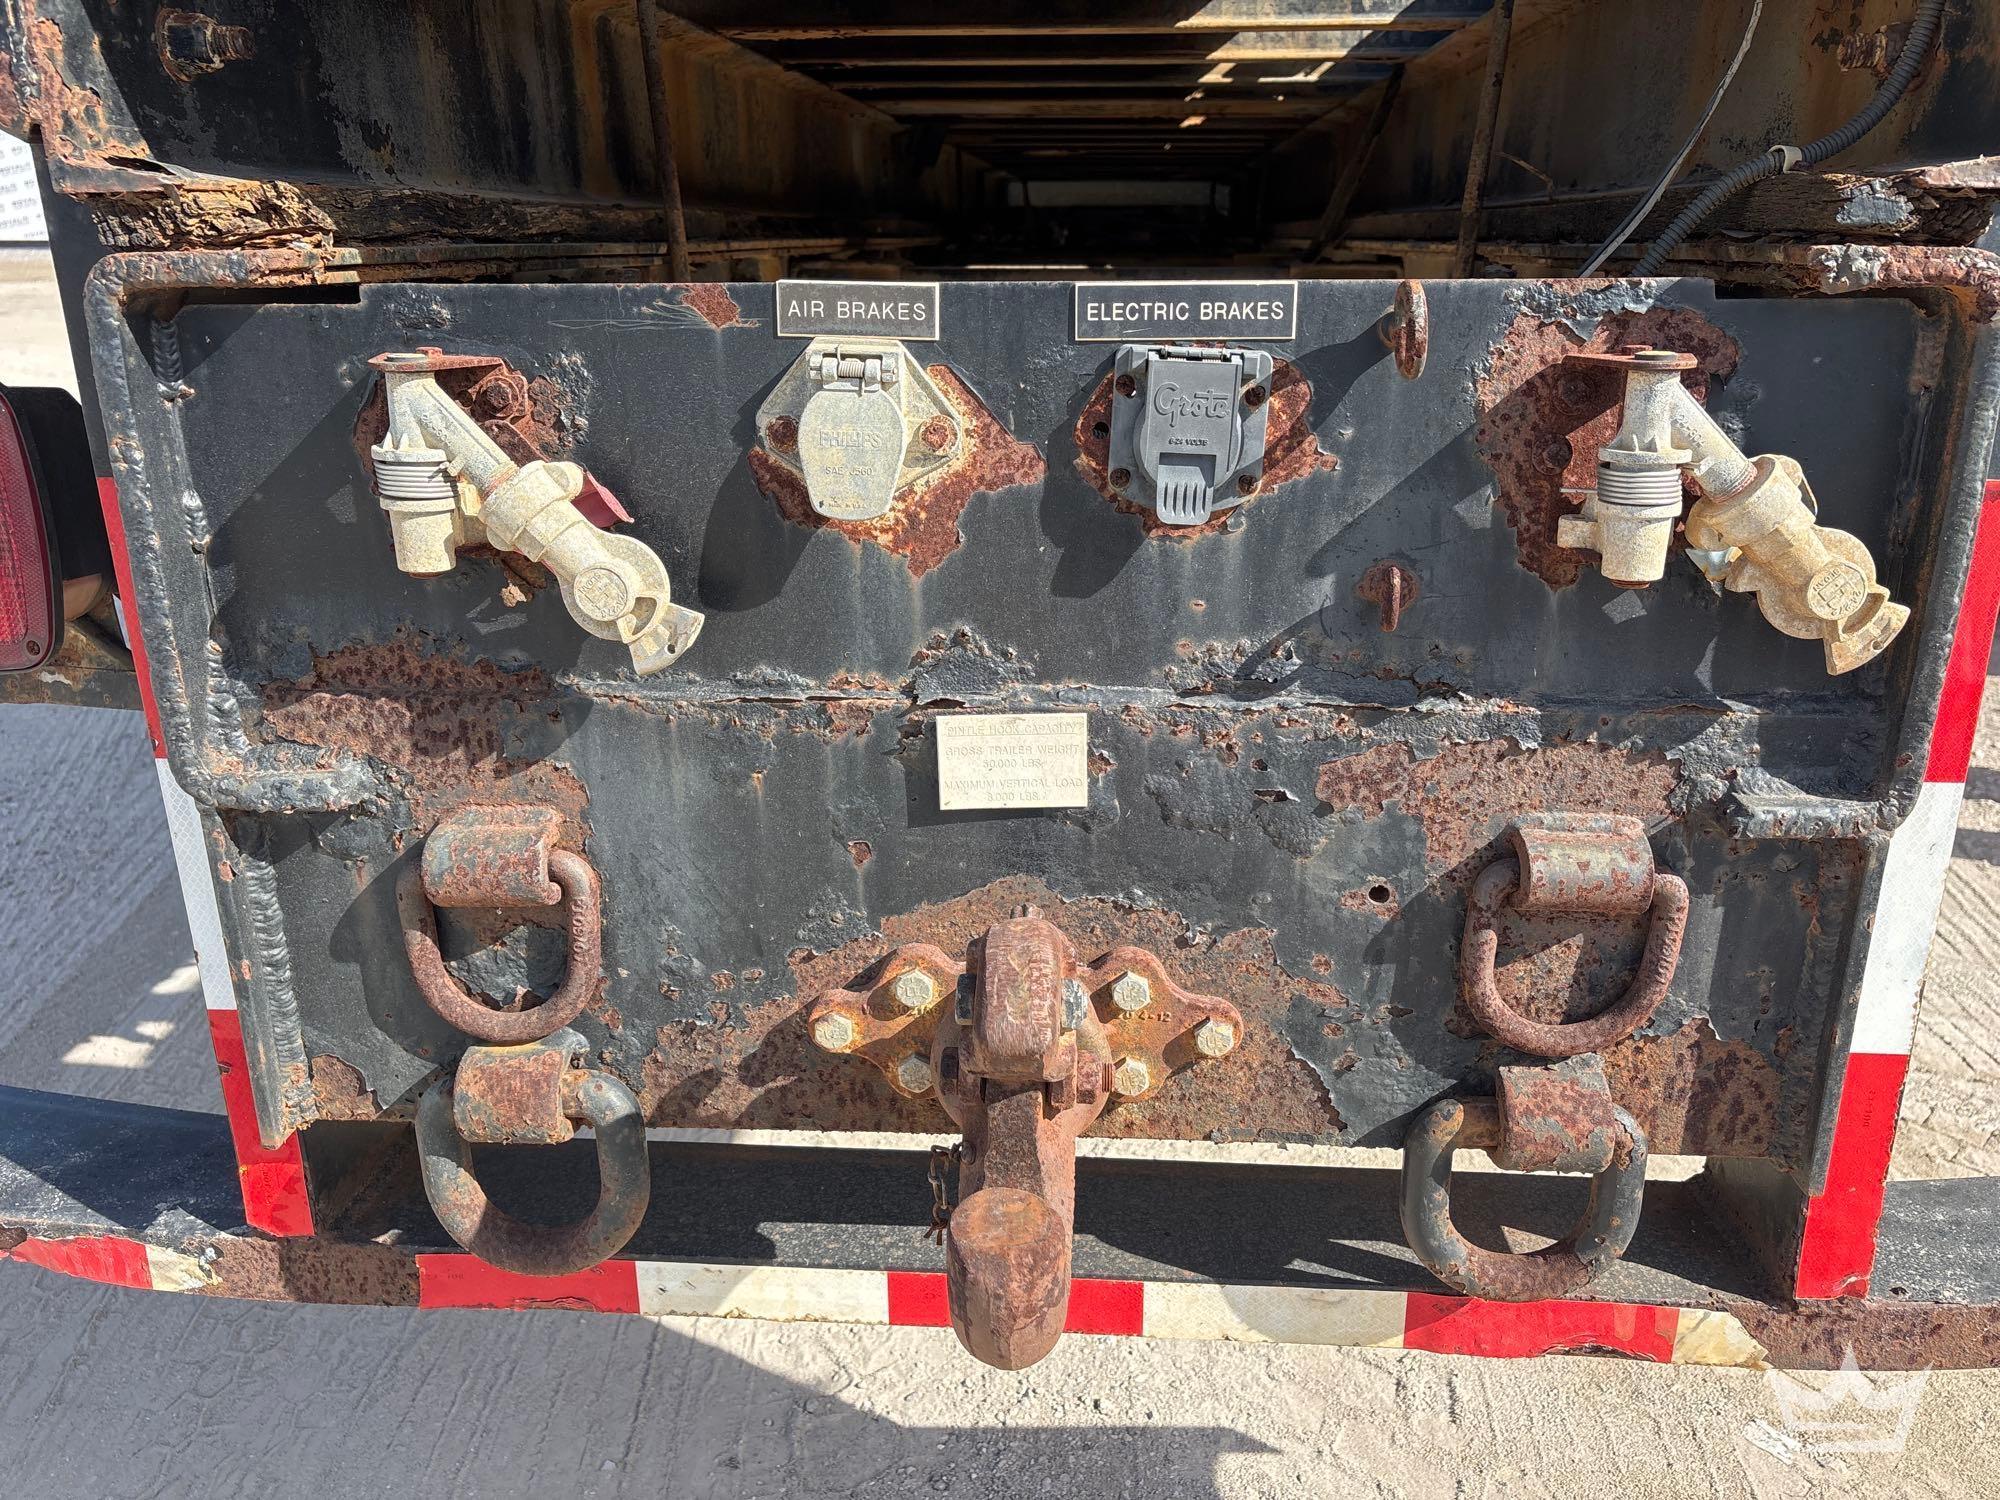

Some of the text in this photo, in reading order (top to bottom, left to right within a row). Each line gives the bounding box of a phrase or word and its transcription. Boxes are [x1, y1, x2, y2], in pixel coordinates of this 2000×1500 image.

[788, 300, 926, 321] AIR BRAKES
[1086, 301, 1284, 322] ELECTRIC BRAKES
[1154, 381, 1229, 427] Grote
[820, 430, 882, 449] PHILLIPS
[825, 466, 844, 475] SAE
[947, 722, 1077, 736] PINTLE HOOK CAPACITY
[945, 744, 1080, 758] GROSS TRAILER WEIGHT
[944, 777, 1083, 792] MAXIMUM VERTICAL LOAD
